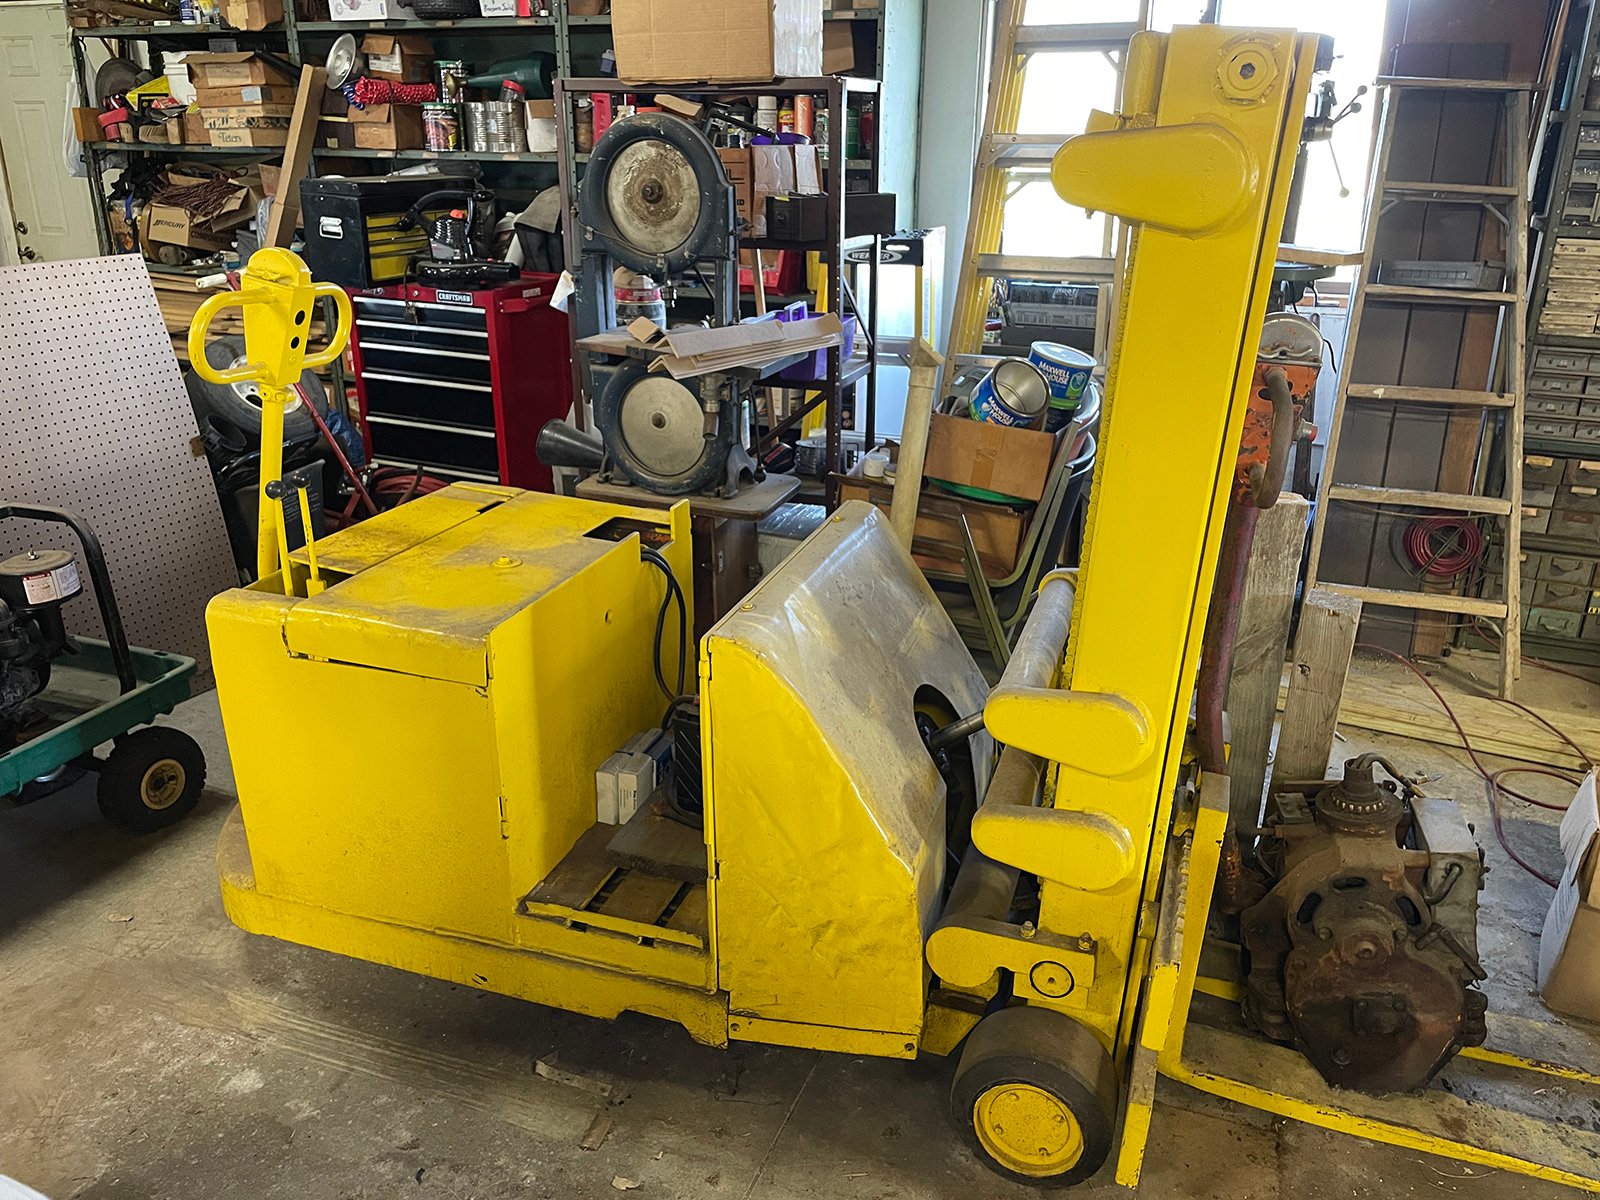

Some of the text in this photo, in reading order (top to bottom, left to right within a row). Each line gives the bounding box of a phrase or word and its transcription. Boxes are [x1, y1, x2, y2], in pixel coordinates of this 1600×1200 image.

[153, 218, 186, 230] MERCURY
[851, 252, 892, 260] WERR
[438, 292, 471, 303] CRAFTSMAN
[1038, 360, 1071, 377] MAXWELL
[1045, 371, 1070, 386] HOUSE
[987, 396, 1015, 423] MAXWELL
[989, 408, 1013, 427] HOUSE
